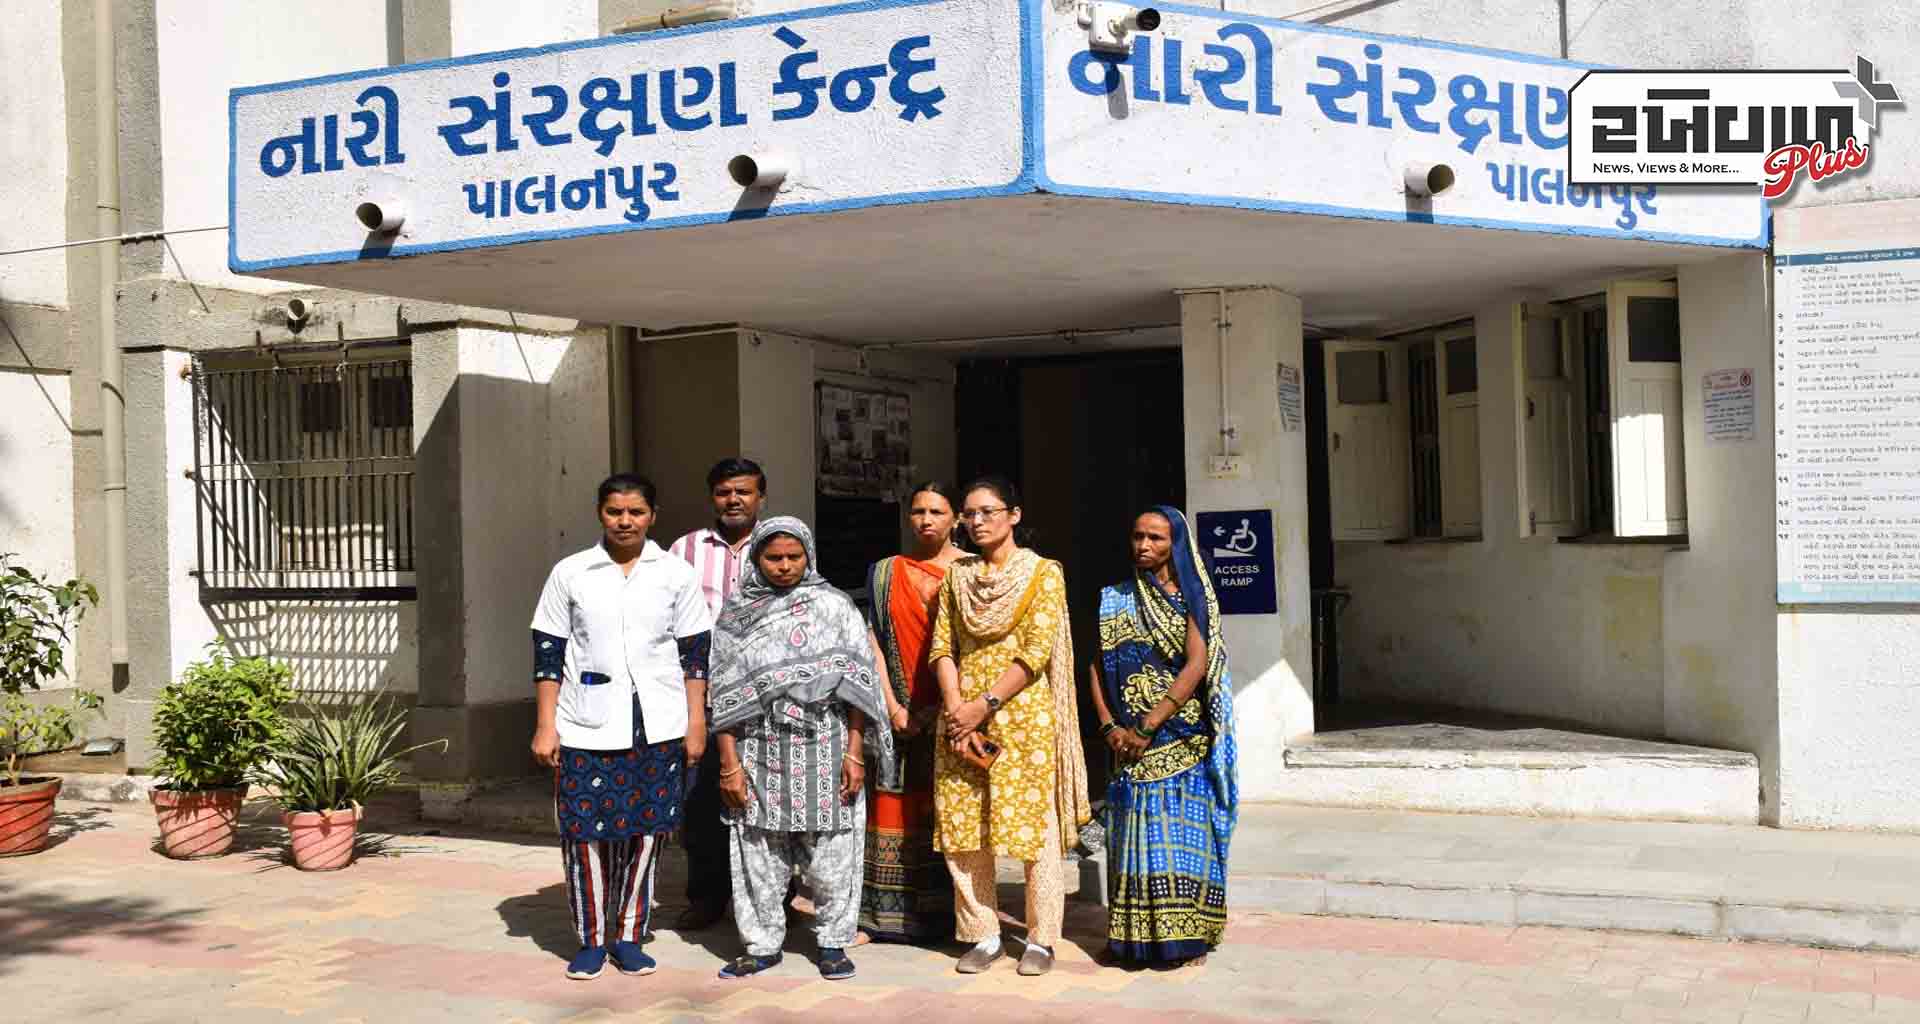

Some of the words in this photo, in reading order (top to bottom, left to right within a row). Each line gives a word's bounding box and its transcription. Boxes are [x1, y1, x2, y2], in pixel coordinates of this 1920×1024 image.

[1067, 22, 1282, 116] નારી
[259, 85, 405, 179] નારી
[437, 60, 748, 157] સંરક્ષણ
[772, 26, 946, 123] કેન્દ્ર
[462, 161, 680, 222] પાલનપુર
[1214, 564, 1261, 576] ACCESS
[1220, 576, 1254, 588] RAMP
